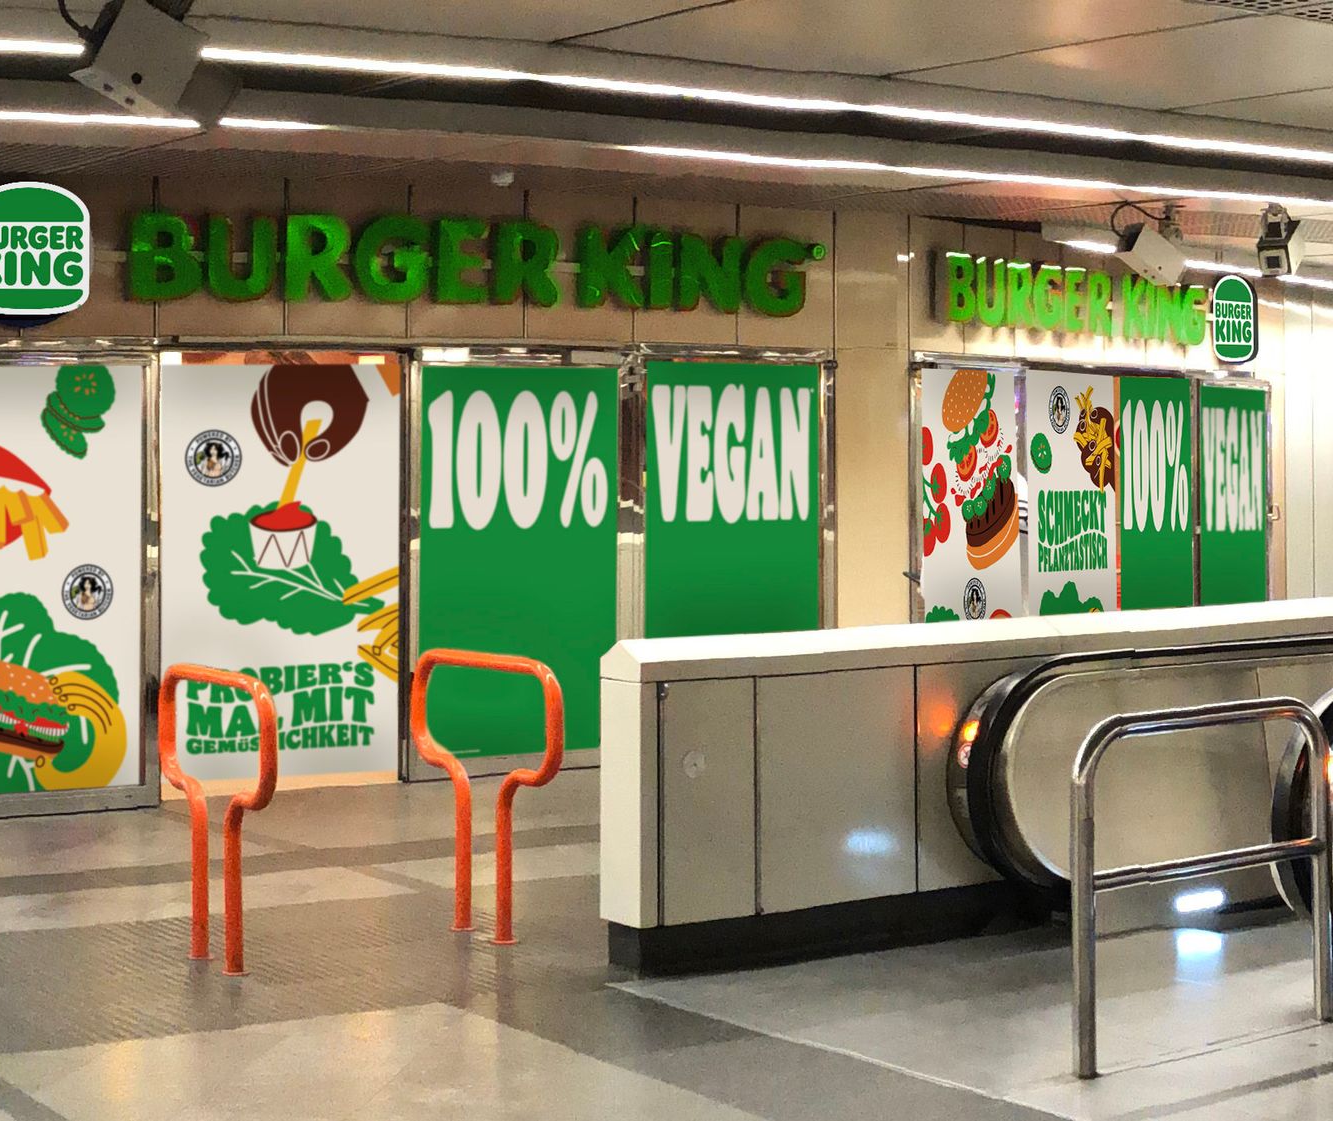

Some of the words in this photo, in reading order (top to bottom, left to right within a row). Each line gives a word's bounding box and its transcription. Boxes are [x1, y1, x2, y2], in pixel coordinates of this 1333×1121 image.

[131, 211, 561, 308] BURGER
[945, 251, 1113, 337] BURGER
[1121, 272, 1206, 346] KING
[1215, 302, 1252, 320] BURGER
[1215, 319, 1252, 343] KING
[428, 389, 609, 531] 100%
[651, 384, 812, 524] VEGAN
[1122, 399, 1189, 533] 100%
[1202, 406, 1264, 534] VEGAN
[1038, 489, 1107, 546] SCHMECKT
[1038, 531, 1108, 573] PFLANZTASTISCH
[186, 702, 284, 738] MA,
[291, 686, 375, 728] MIT
[186, 724, 375, 755] GEMÜSICHKEIT
